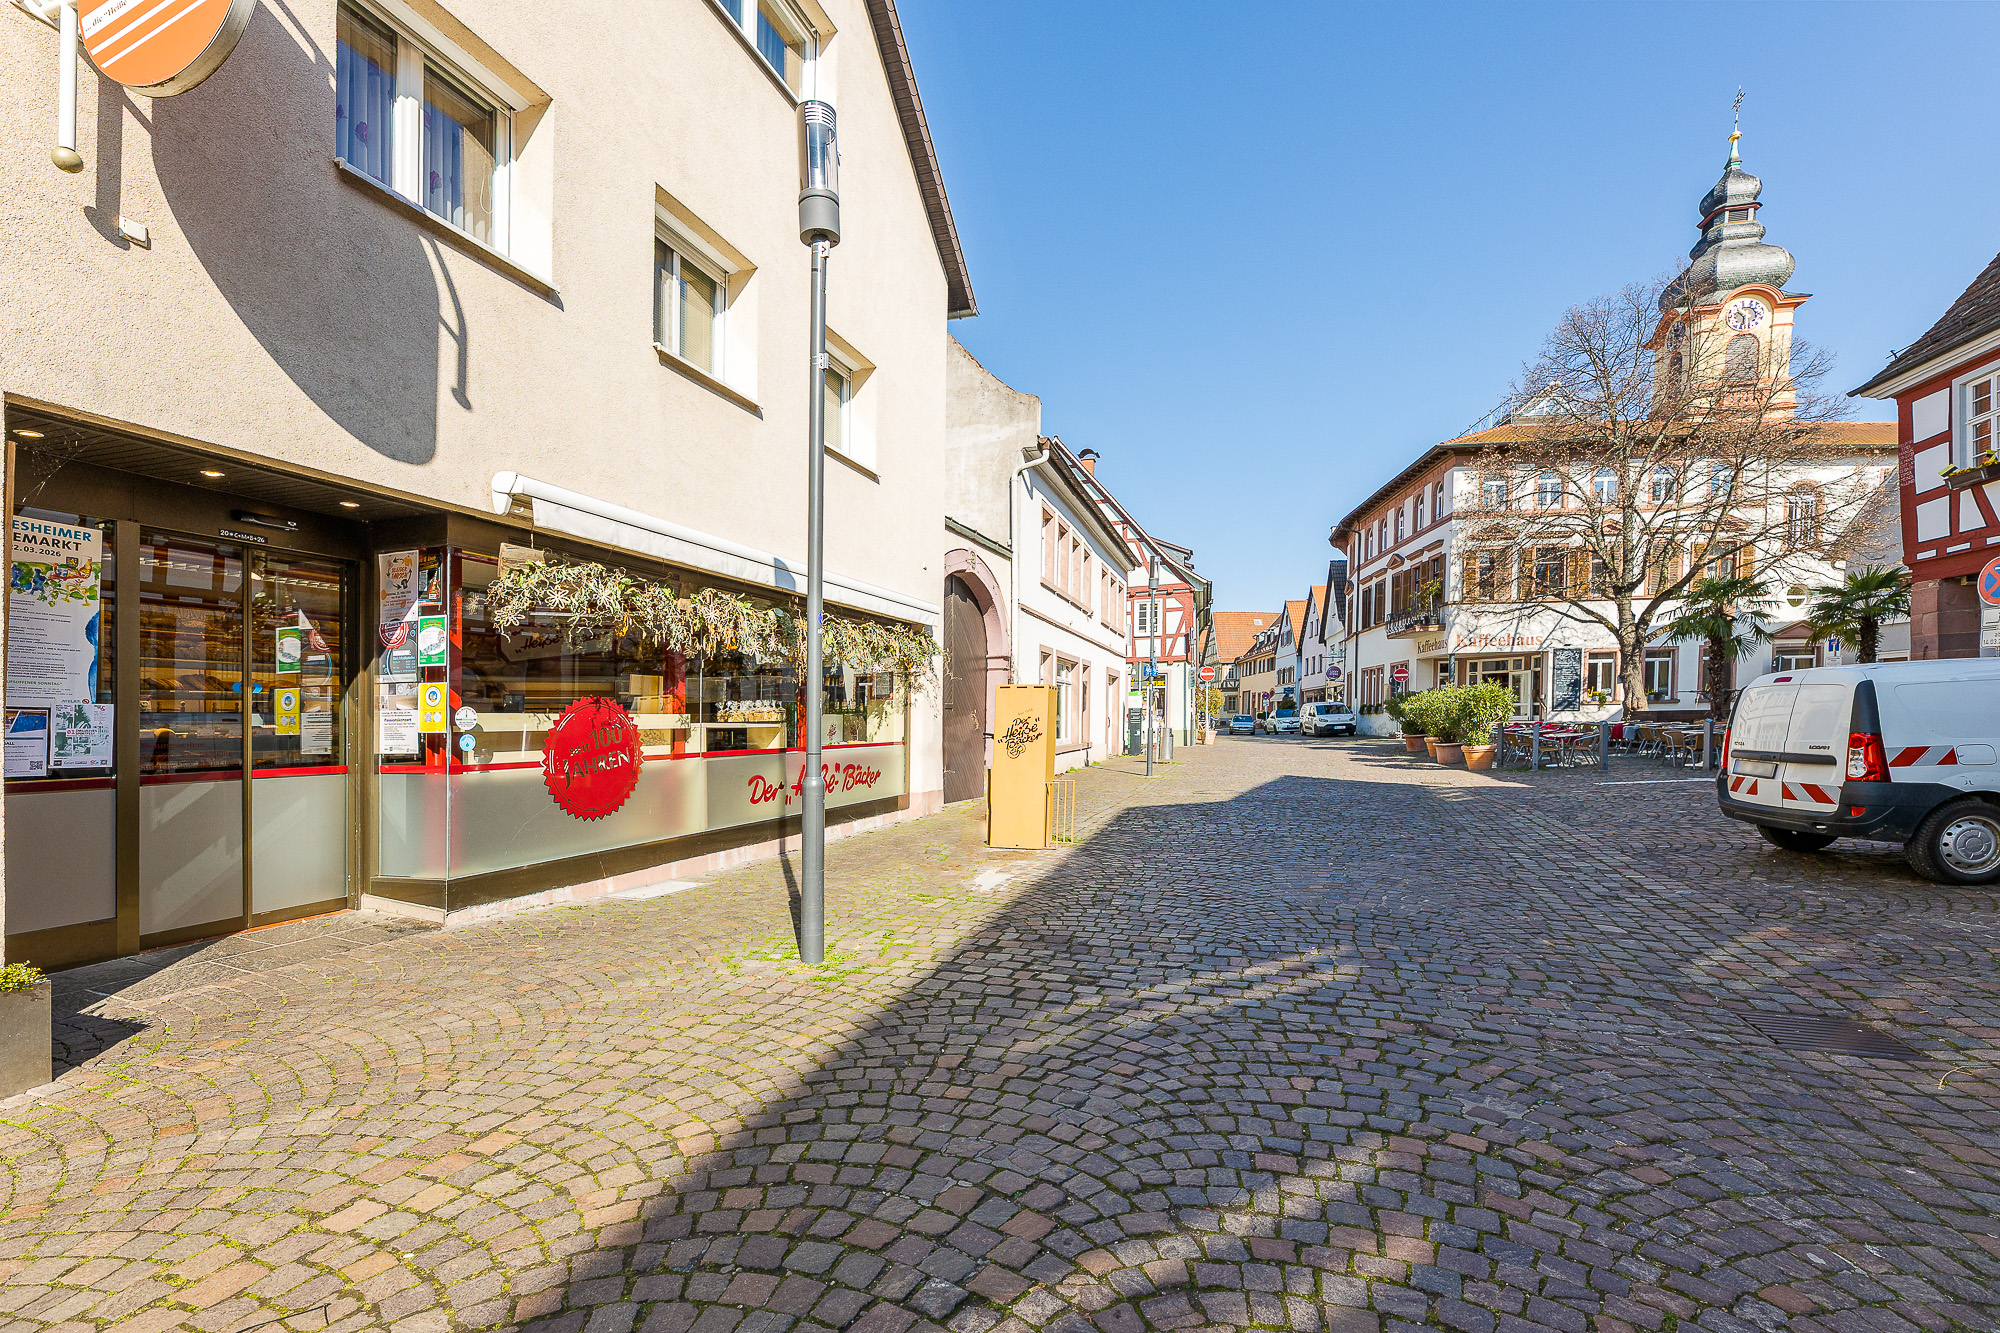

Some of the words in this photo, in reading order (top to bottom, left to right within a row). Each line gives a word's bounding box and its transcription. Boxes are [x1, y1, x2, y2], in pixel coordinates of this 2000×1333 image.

[12, 519, 92, 542] ESHEIMER
[13, 531, 82, 552] EMARKT
[1416, 637, 1448, 655] Kaffeehaus
[1456, 632, 1543, 648] Kaffeehaus
[569, 741, 590, 757] seit
[588, 723, 623, 750] 100
[563, 746, 630, 790] JAHREN
[748, 774, 785, 805] Der
[842, 763, 882, 793] Bäcker
